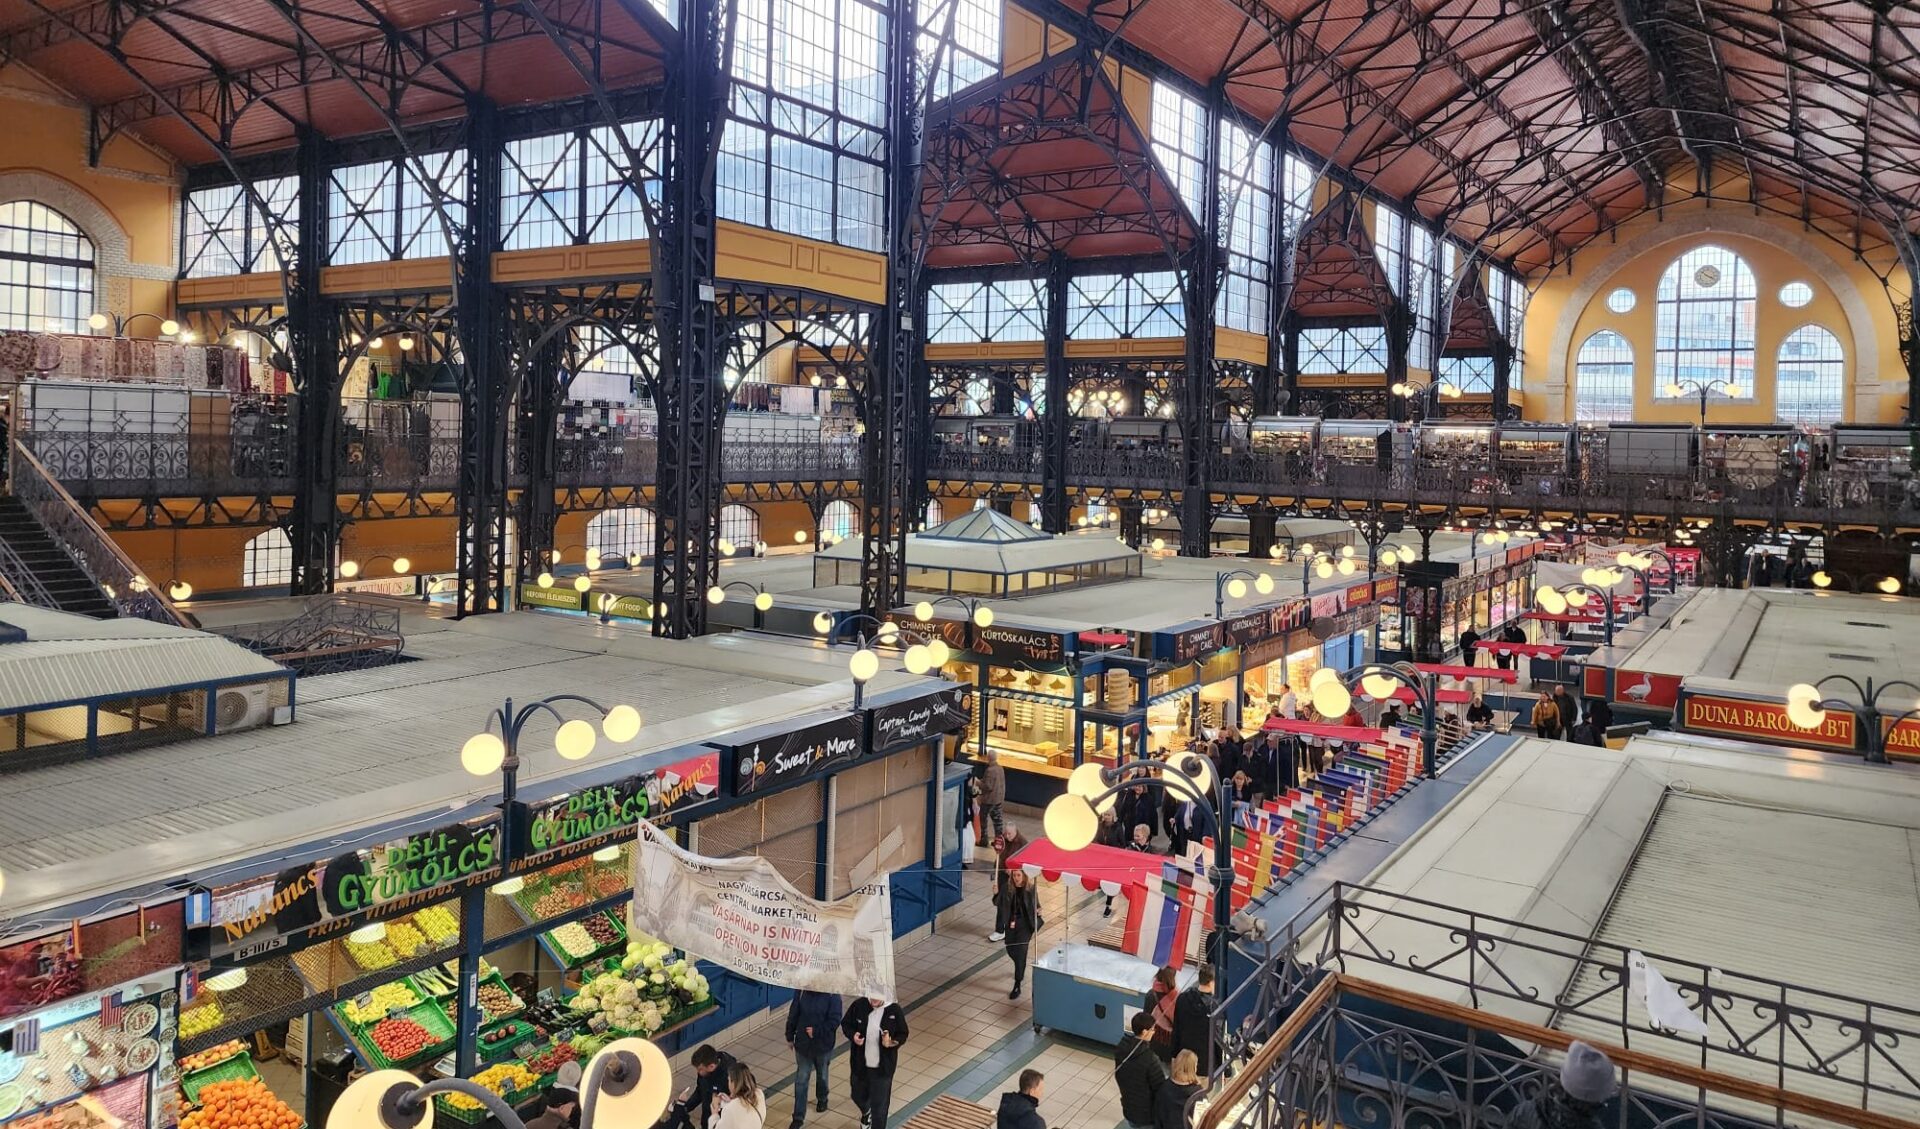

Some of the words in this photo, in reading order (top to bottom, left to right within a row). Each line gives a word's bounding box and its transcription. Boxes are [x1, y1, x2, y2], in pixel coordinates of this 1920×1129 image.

[900, 620, 937, 632] CHIMNEY
[920, 632, 942, 642] CAKE
[908, 707, 931, 722] Candy
[932, 702, 949, 716] Shop
[1692, 703, 1740, 726] DUNA
[1744, 708, 1824, 736] BARO
[1826, 718, 1850, 738] BT
[774, 745, 814, 774] Sweet
[814, 745, 824, 760] &
[826, 737, 856, 757] More
[658, 757, 713, 809] Narancs
[388, 831, 457, 868] DÉLI-
[338, 832, 495, 911] GYÜMÖLCS
[221, 868, 318, 945] Narancs
[717, 892, 750, 911] CENTRAL
[751, 904, 793, 918] MARKET
[796, 911, 818, 923] HALL
[711, 904, 760, 935] VASÁRNAP
[763, 925, 777, 939] IS
[781, 928, 822, 948] NYITVA
[715, 928, 741, 950] OPEN
[741, 940, 758, 957] ON
[761, 946, 812, 966] SUNDAY
[732, 956, 783, 980] 10.00-16.00
